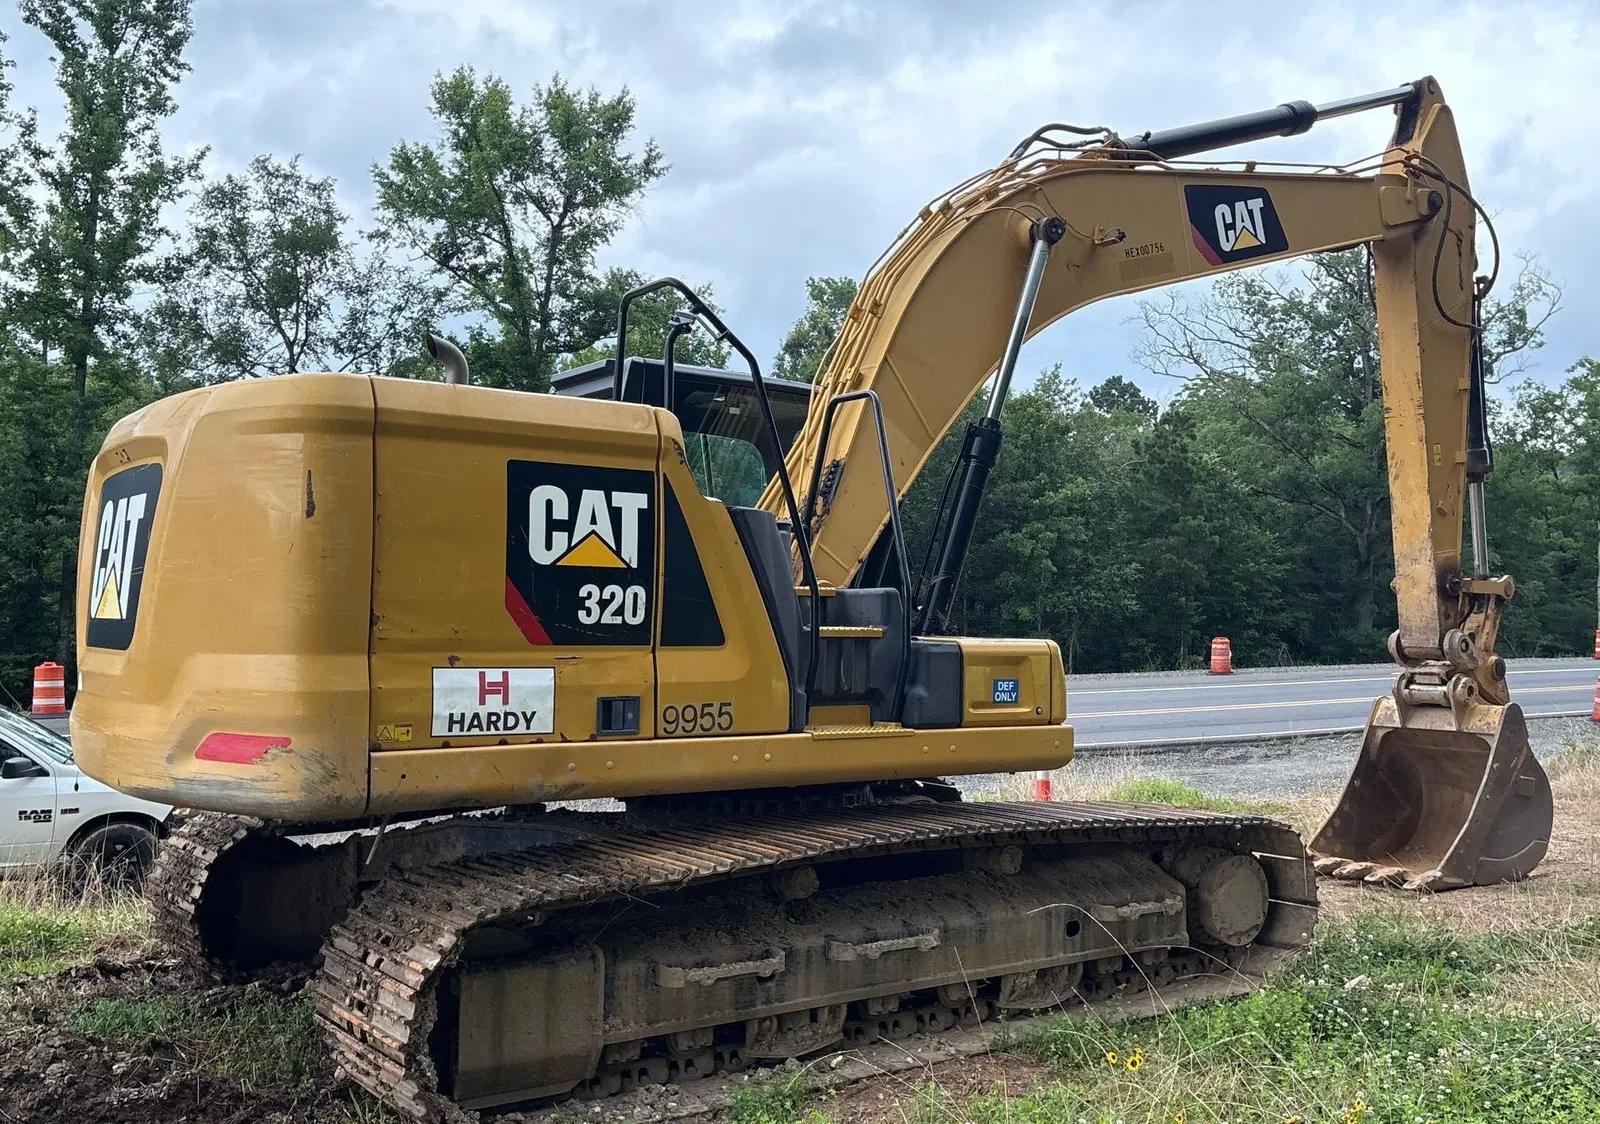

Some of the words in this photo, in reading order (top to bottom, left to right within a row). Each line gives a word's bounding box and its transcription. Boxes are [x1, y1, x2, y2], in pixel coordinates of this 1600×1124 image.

[1214, 198, 1266, 252] CAT
[1124, 242, 1165, 259] HEX00756
[528, 484, 648, 569] CAT
[91, 493, 148, 620] CAT
[577, 584, 646, 625] 320
[994, 691, 1017, 702] ONLY
[997, 681, 1015, 691] DEF
[447, 711, 537, 732] HARDY
[662, 702, 734, 735] 9955
